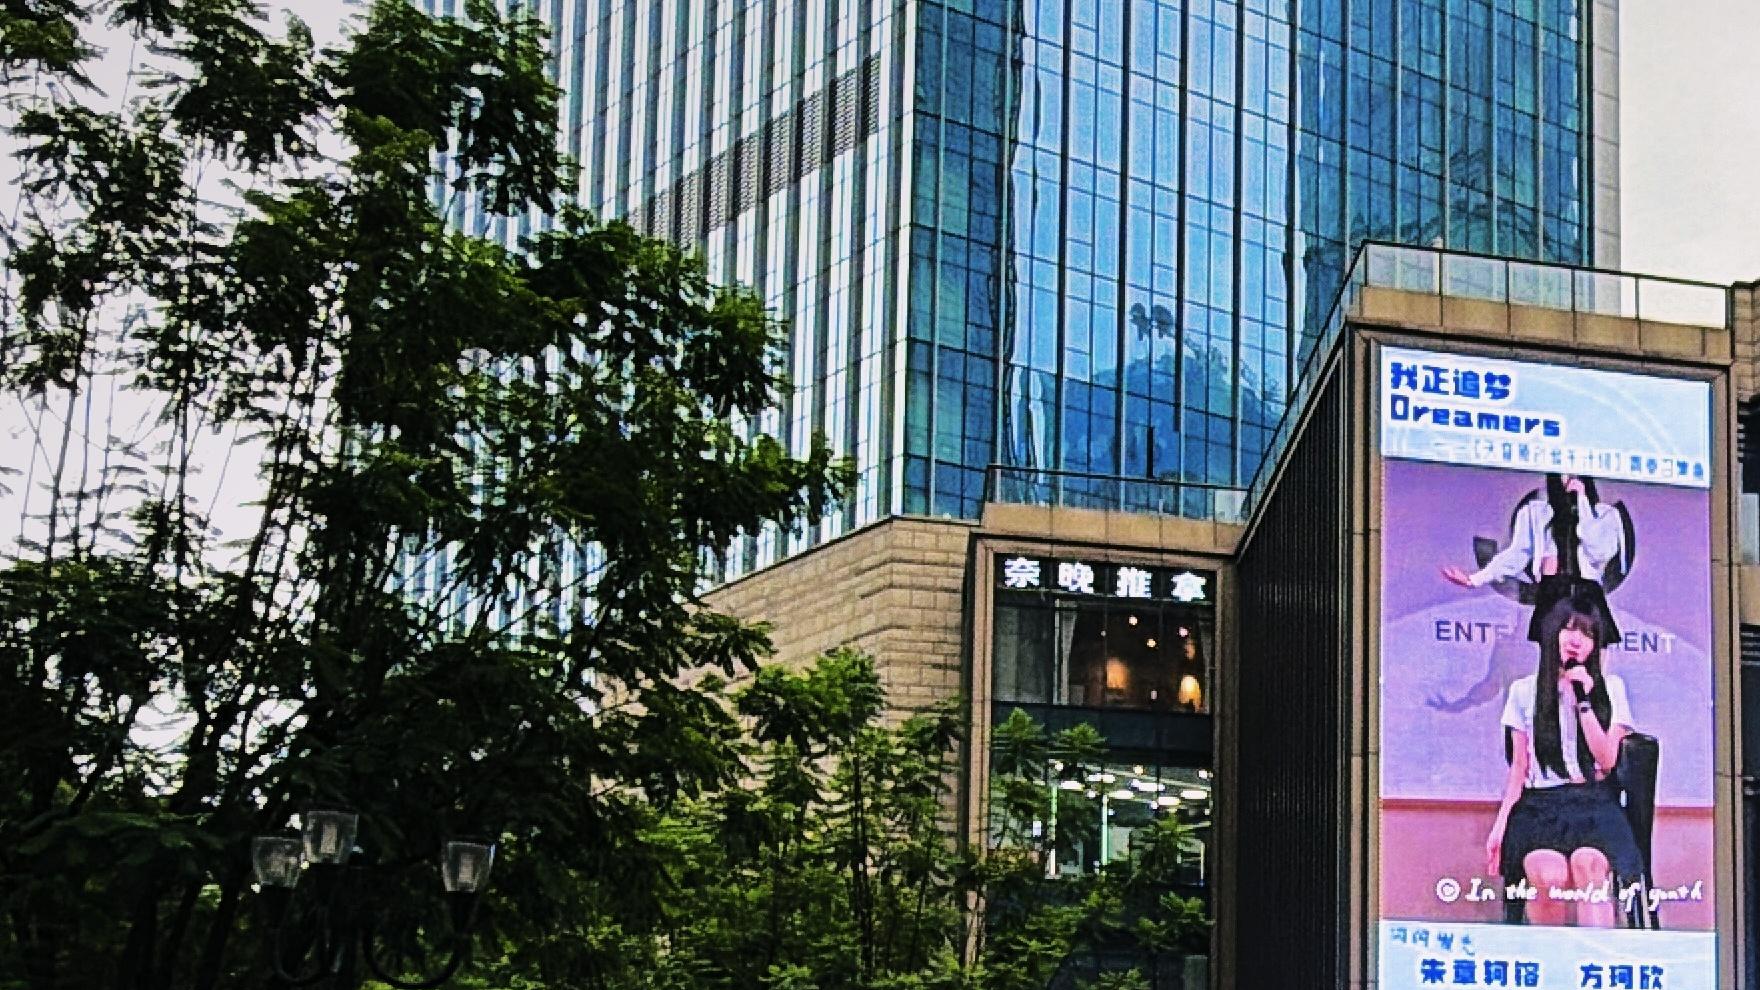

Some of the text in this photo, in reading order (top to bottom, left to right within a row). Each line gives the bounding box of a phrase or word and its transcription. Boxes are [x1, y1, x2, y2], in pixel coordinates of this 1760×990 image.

[1390, 393, 1560, 437] Dreamers
[1465, 877, 1496, 902] In
[1505, 878, 1538, 900] the
[1549, 879, 1611, 903] world
